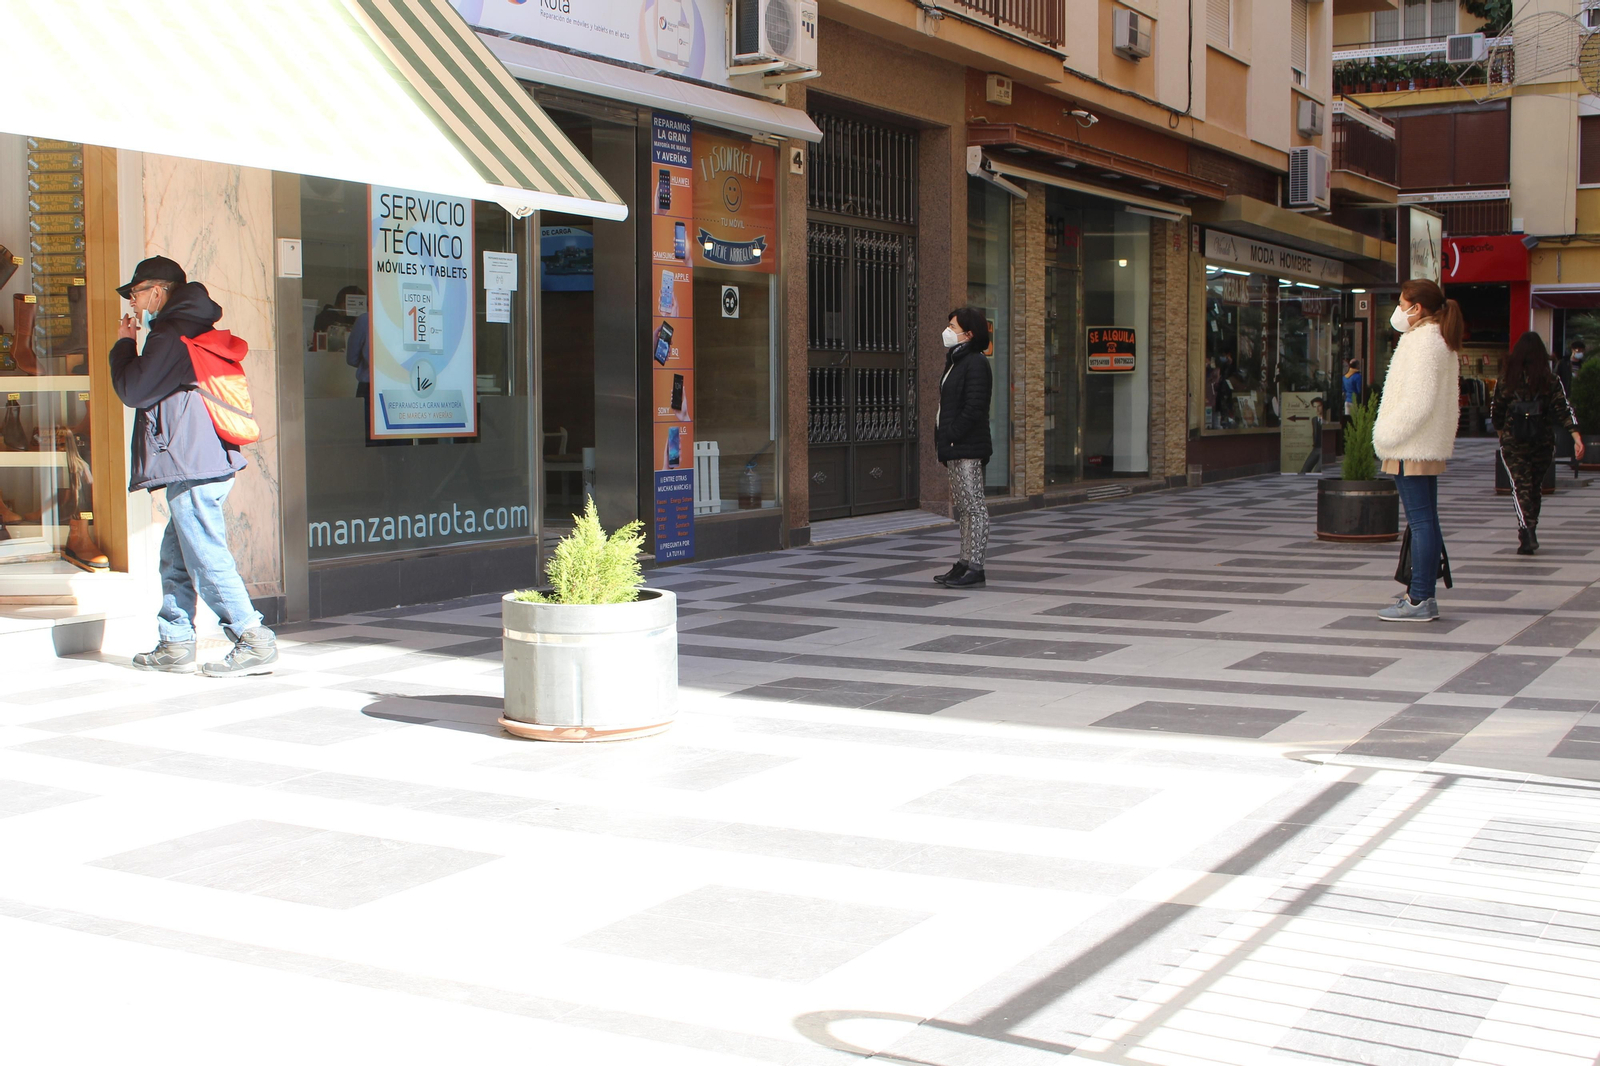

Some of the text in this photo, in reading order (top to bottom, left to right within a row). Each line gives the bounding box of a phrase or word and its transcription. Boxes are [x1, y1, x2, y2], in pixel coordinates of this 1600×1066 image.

[540, 10, 565, 23] Reparación
[566, 16, 572, 24] de
[573, 18, 589, 28] móviles
[594, 24, 608, 34] tablets
[615, 28, 619, 36] el
[620, 30, 630, 39] acto
[654, 117, 690, 132] REPARAMOS
[658, 129, 686, 143] LA GRAN
[656, 151, 687, 164] Y AVERÍAS
[793, 152, 802, 168] 4
[672, 176, 690, 185] HUAWEI
[380, 194, 465, 227] SERVICIO
[721, 218, 745, 228] TU MÓVIL
[379, 224, 462, 259] TÉCNICO
[653, 251, 675, 259] SAMSUNG
[1251, 245, 1312, 273] MODA HOMBRE
[377, 259, 467, 279] MÓVILES Y TABLETS
[675, 273, 689, 281] APPLE
[404, 294, 431, 303] LISTO EN
[408, 306, 426, 342] 1 HORA
[1090, 330, 1134, 344] SE ALQUILA
[671, 348, 679, 356] BQ
[441, 400, 461, 408] MAYORÍA
[308, 502, 528, 547] manzanarota.com
